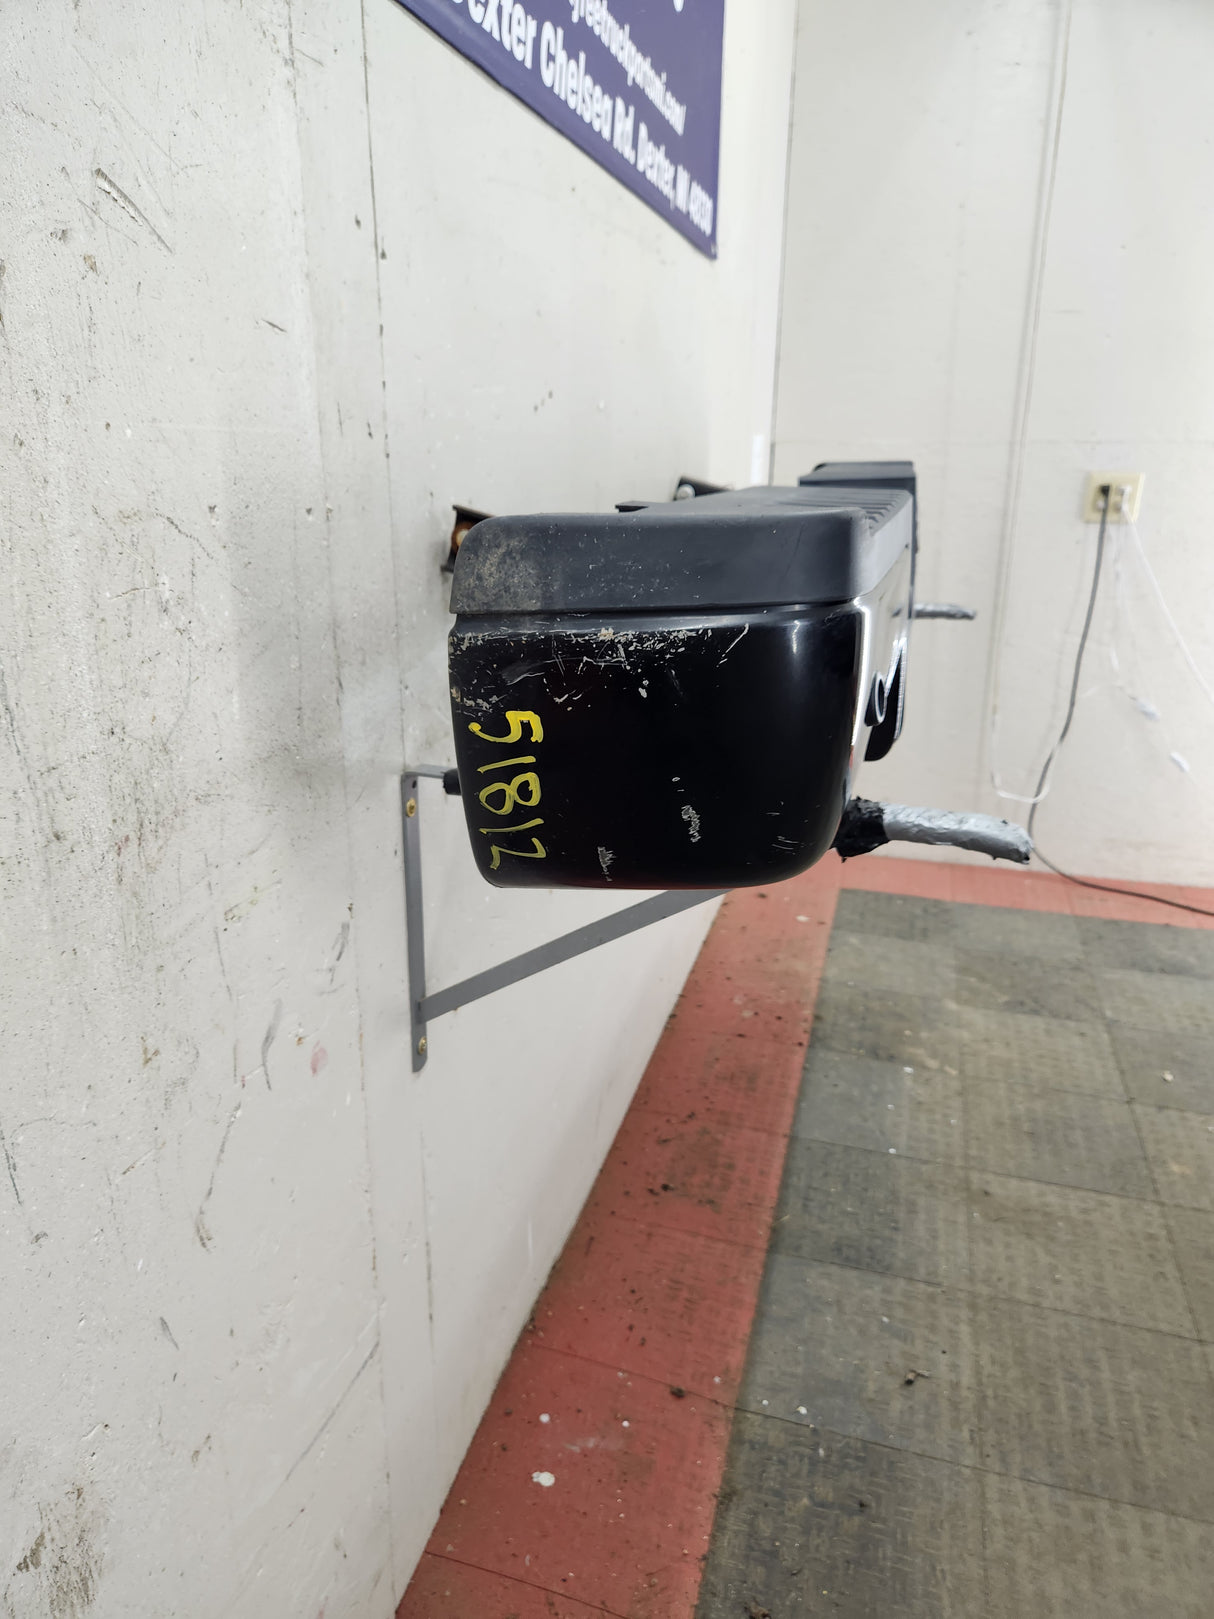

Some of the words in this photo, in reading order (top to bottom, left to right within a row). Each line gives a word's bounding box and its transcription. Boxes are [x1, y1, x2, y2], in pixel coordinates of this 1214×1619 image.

[540, 21, 613, 142] Chelsea
[613, 96, 635, 165] Rd.
[468, 710, 547, 870] 51812
